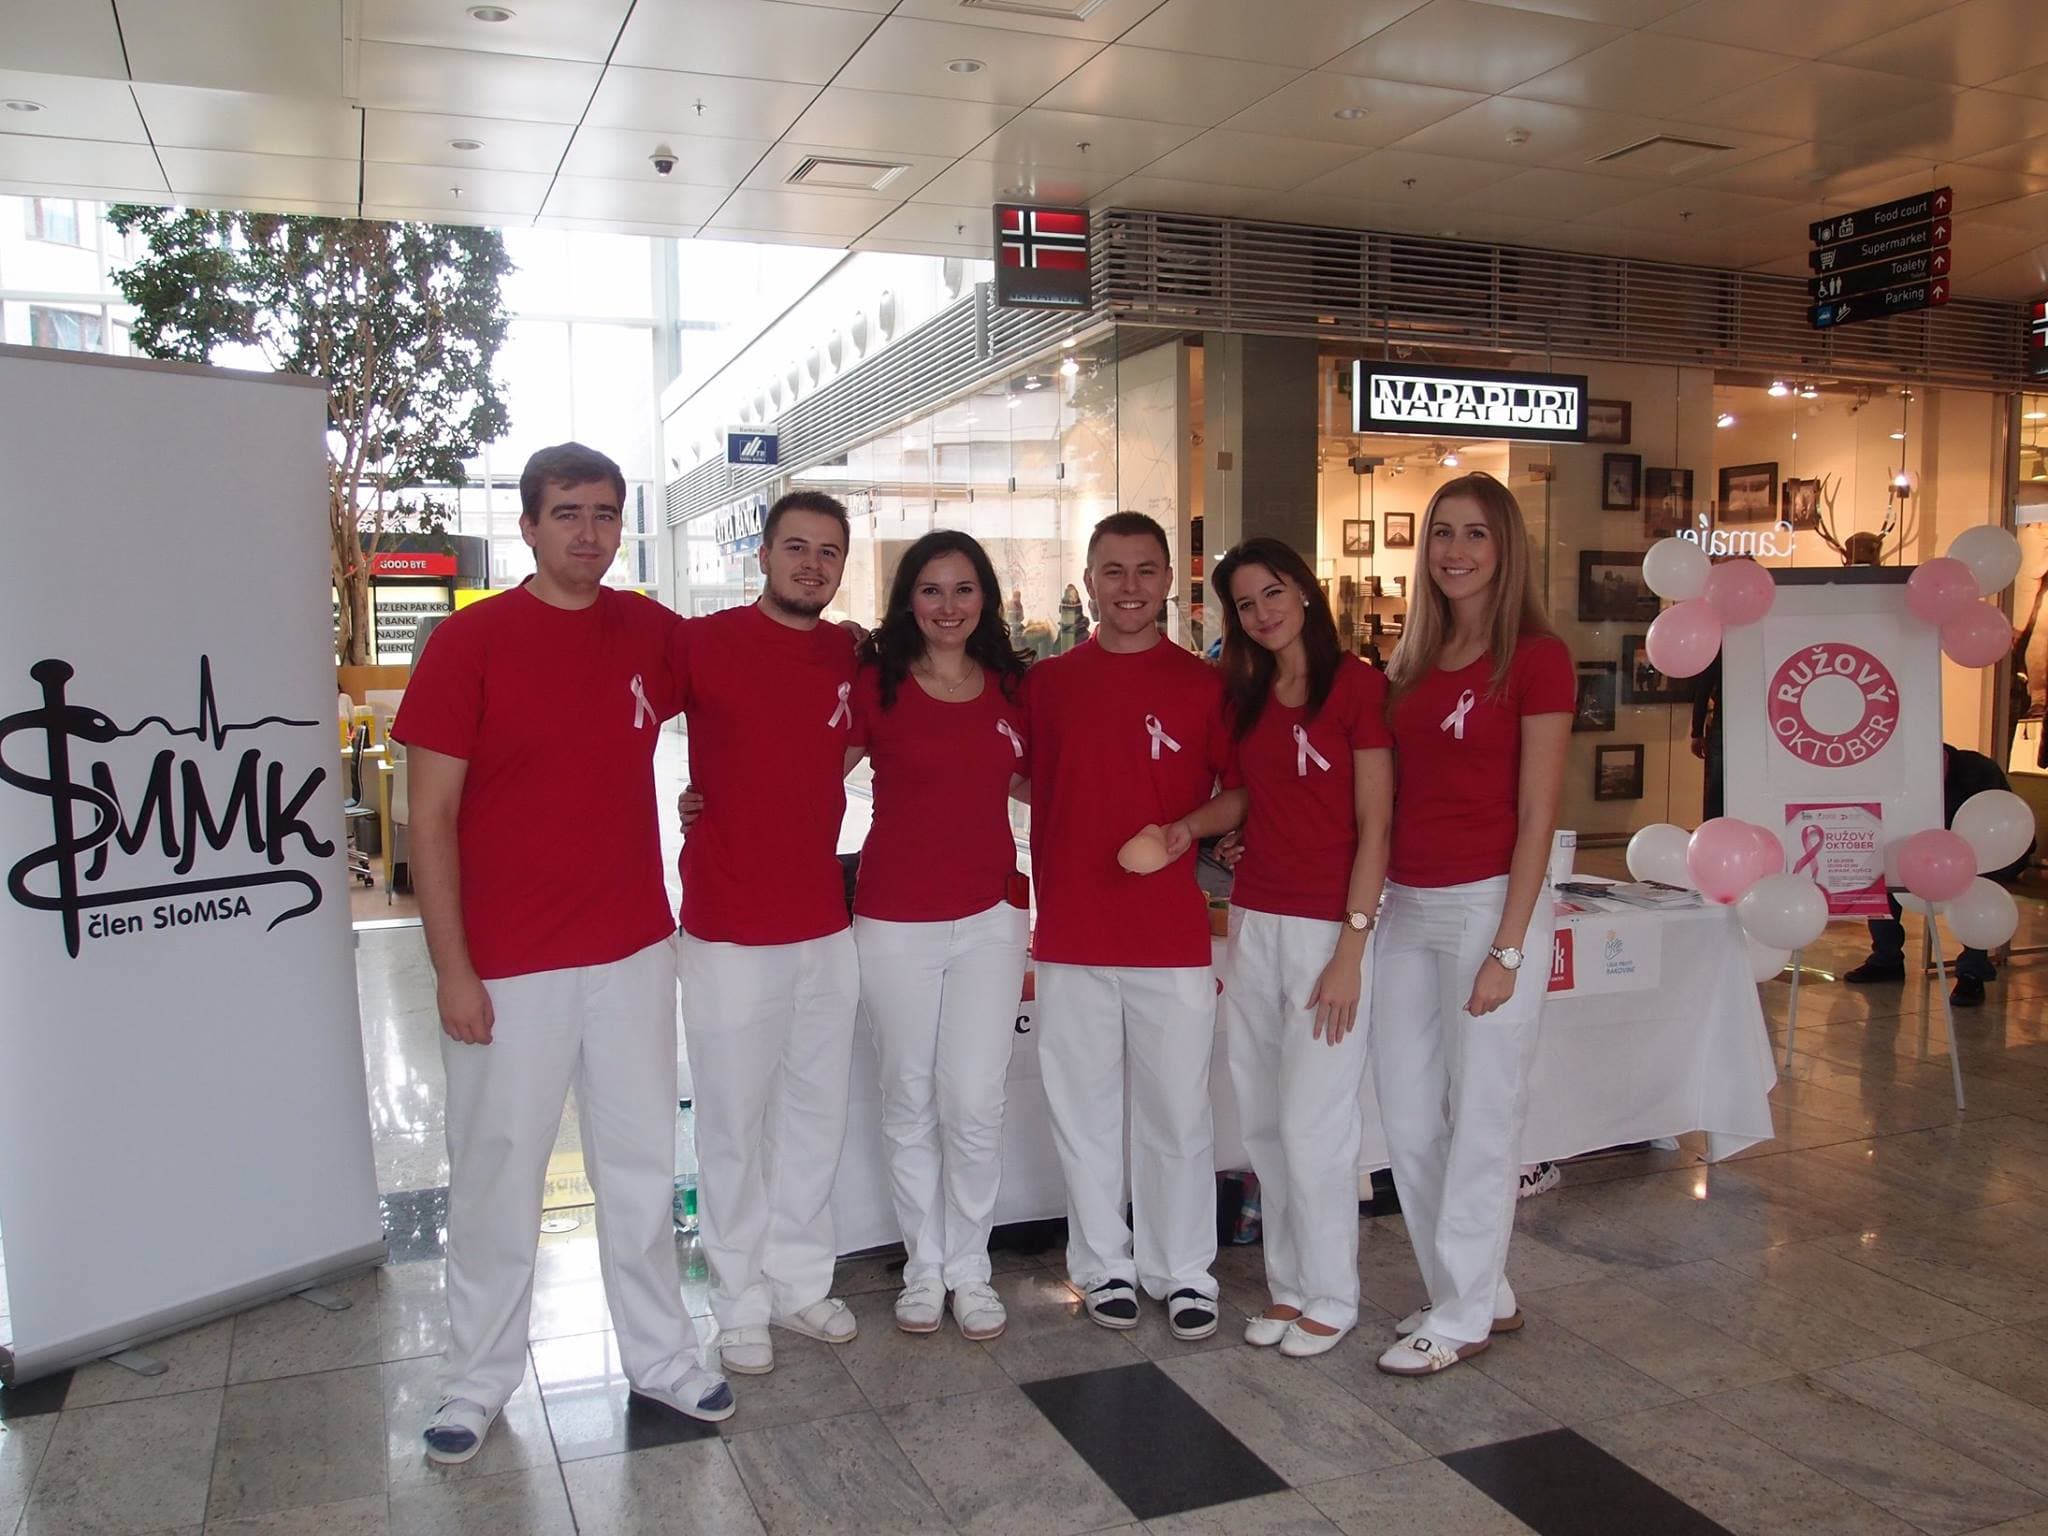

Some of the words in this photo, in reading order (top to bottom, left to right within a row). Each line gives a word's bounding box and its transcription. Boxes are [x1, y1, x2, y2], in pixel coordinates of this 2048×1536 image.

[1874, 208, 1898, 224] Food
[1900, 201, 1927, 217] court
[1861, 231, 1927, 256] Supermarket
[1891, 258, 1927, 275] Toalety
[1885, 287, 1925, 304] Parking
[1375, 379, 1574, 425] NAPAPIJRI
[380, 560, 409, 569] GOOD
[410, 560, 427, 569] BYE
[391, 603, 408, 612] LEN
[385, 617, 416, 625] BANKE
[1777, 646, 1896, 704] RUŽOVÝ
[1776, 714, 1895, 764] OKTÓBER
[87, 913, 143, 939] člen
[153, 895, 252, 930] SloMSA
